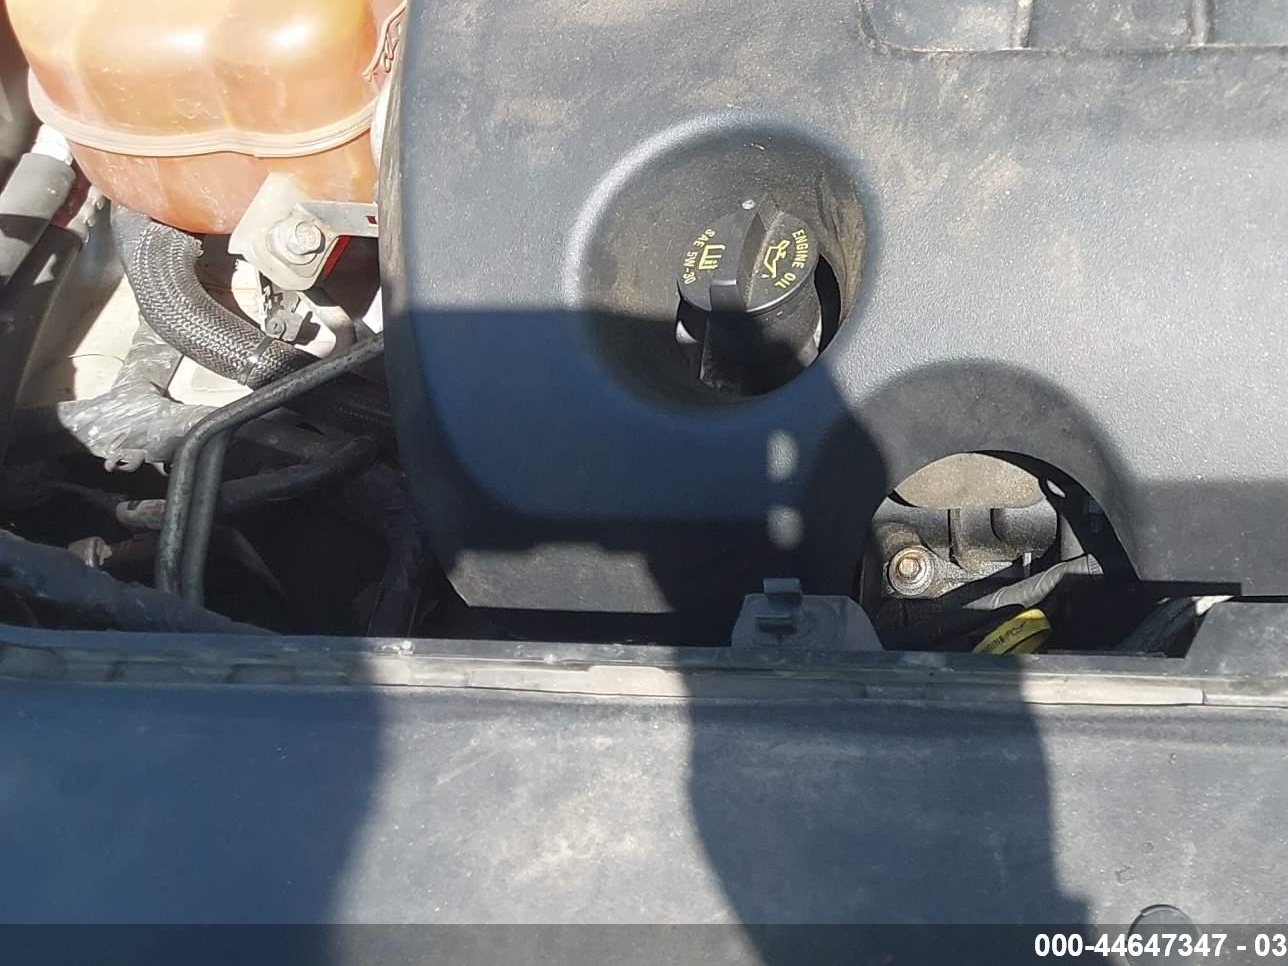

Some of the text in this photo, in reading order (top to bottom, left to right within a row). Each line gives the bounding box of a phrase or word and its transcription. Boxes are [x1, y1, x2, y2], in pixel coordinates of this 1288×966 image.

[682, 228, 715, 284] SAE 5W-30
[775, 230, 808, 289] ENGINE OIL
